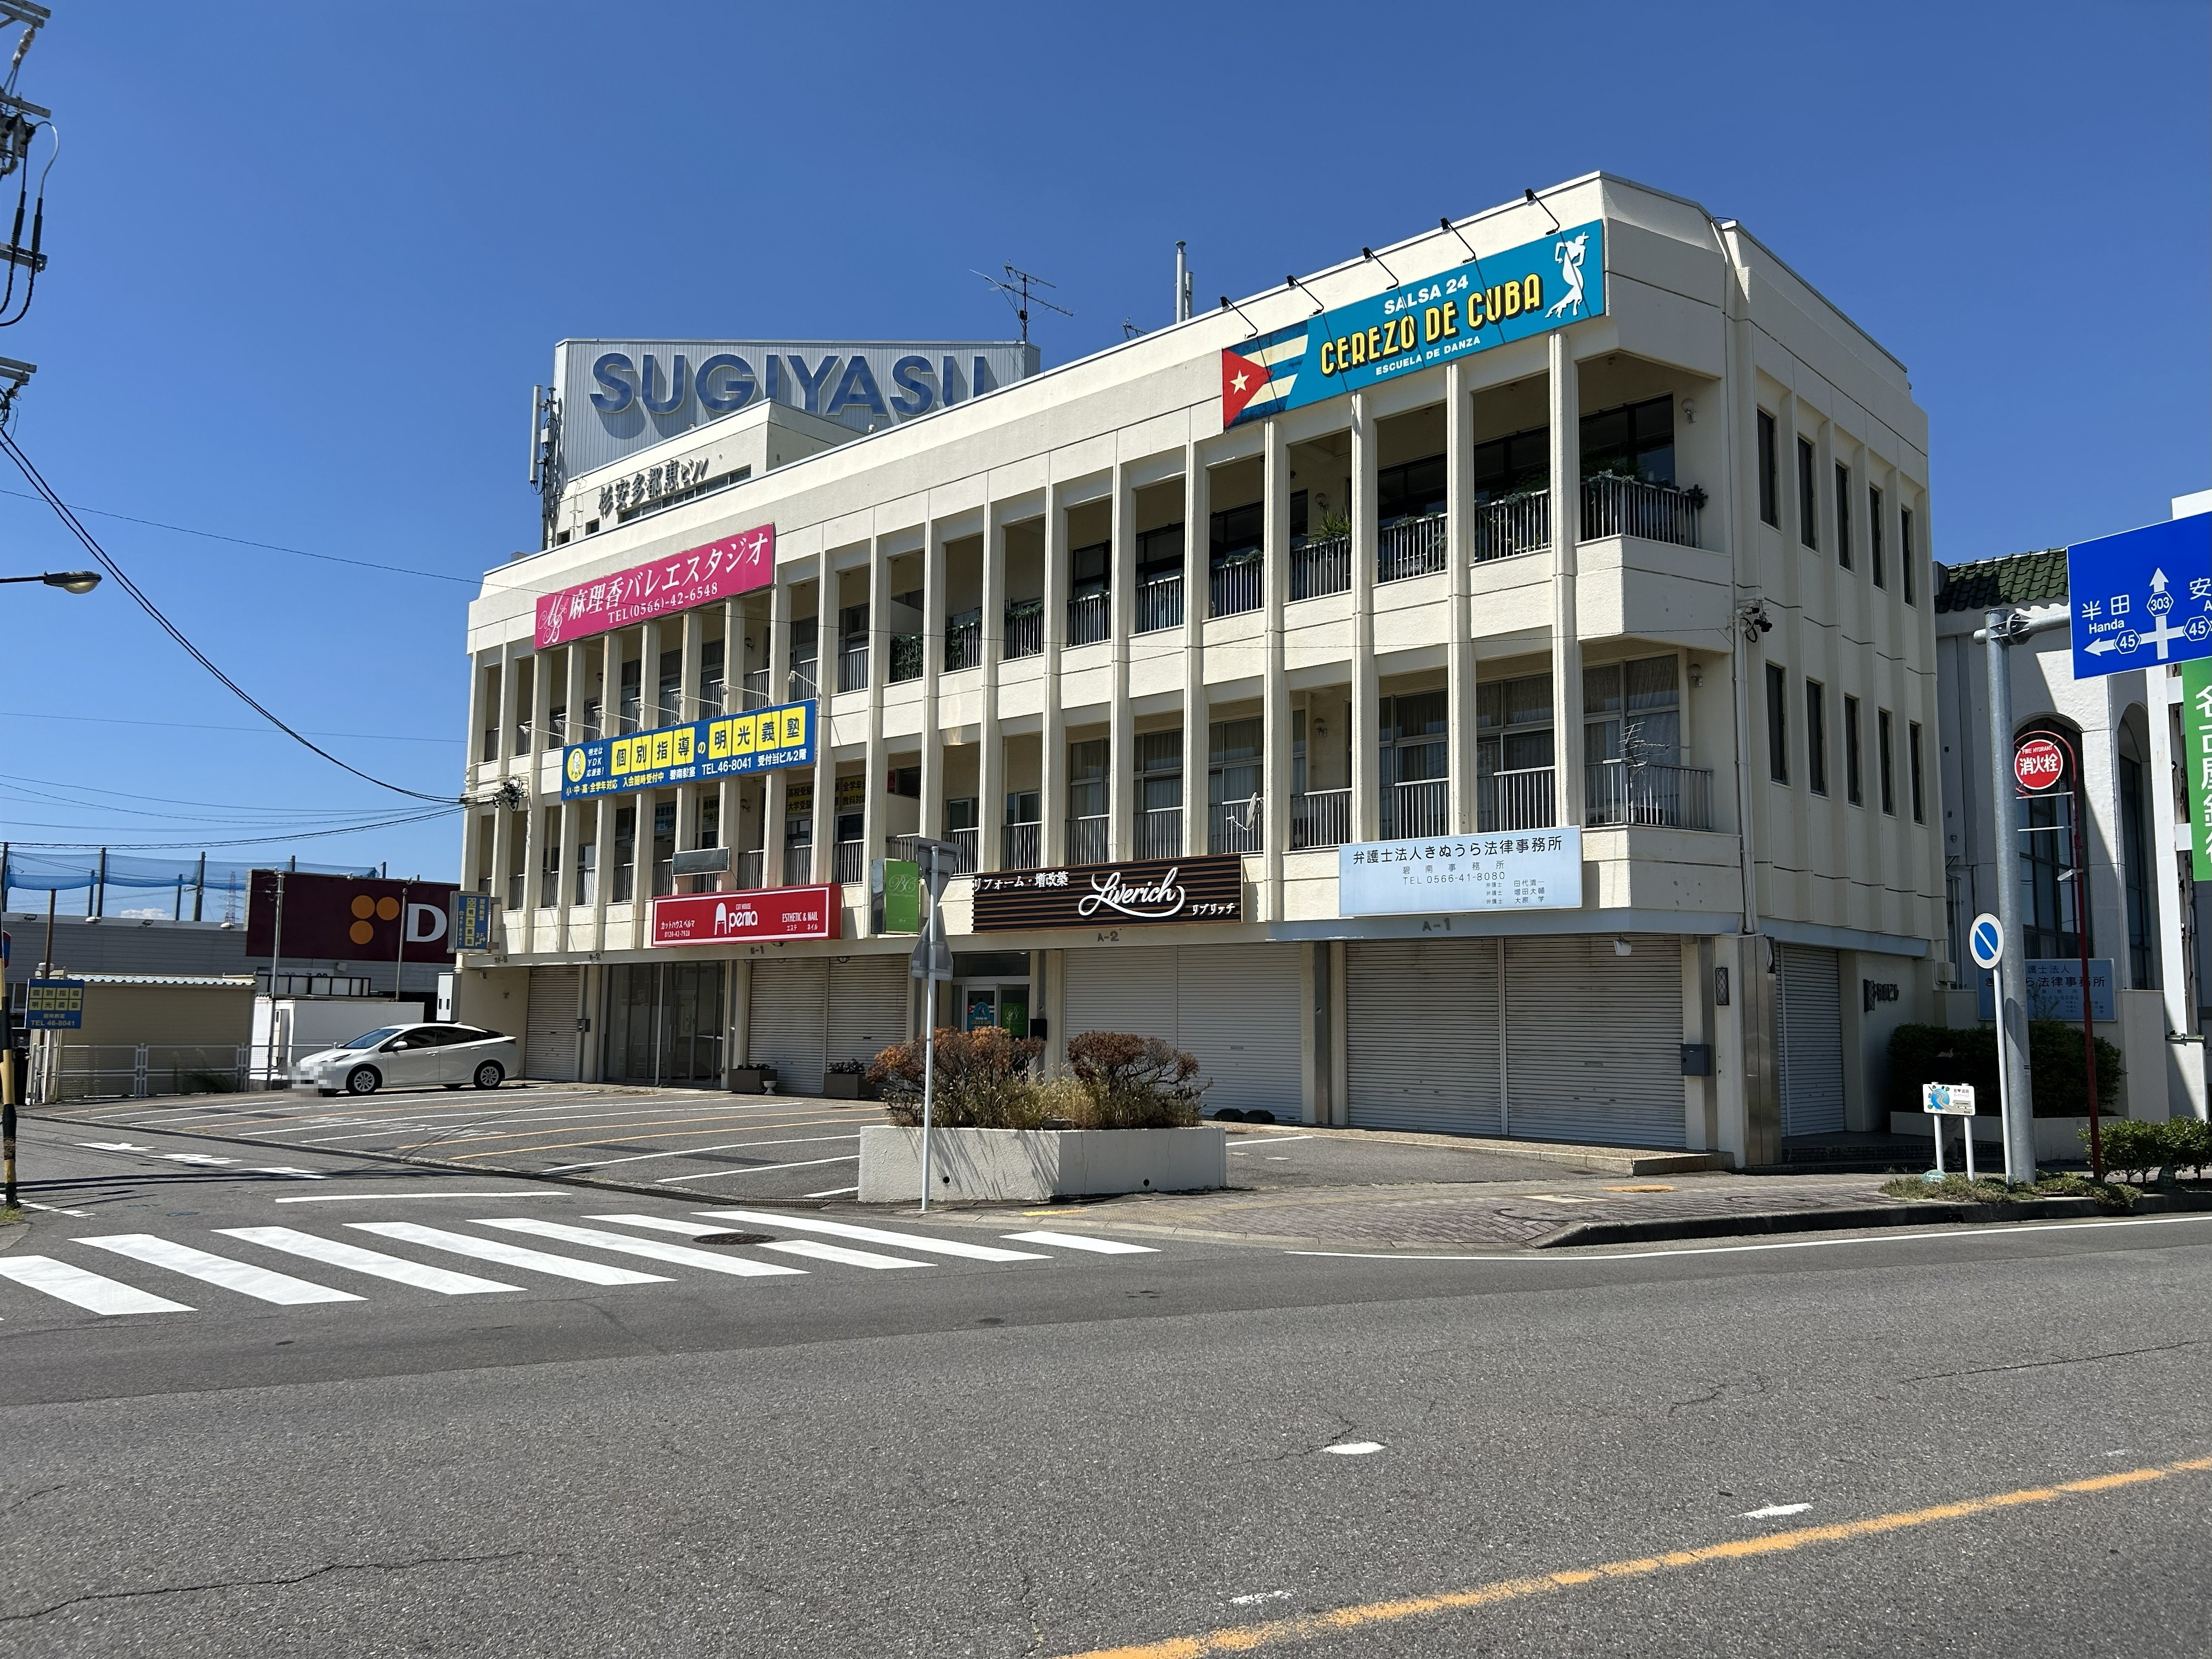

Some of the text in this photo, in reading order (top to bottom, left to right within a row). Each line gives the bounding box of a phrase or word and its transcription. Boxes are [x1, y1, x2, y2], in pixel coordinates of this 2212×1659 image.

[1384, 275, 1468, 315] SALSA 24
[1321, 273, 1541, 375] CEREZO DE CUBA
[1375, 336, 1481, 376] ESCUELA DE DANZA
[590, 353, 988, 417] SUGIYASU
[568, 533, 768, 621] 麻理香バレエスタジオ
[2081, 594, 2130, 620] 半田
[2151, 597, 2170, 611] 303
[2089, 619, 2125, 634] Handa
[2189, 621, 2205, 635] 45
[2120, 634, 2135, 648] 45
[588, 757, 602, 766] YDK
[2019, 753, 2058, 776] 消火栓
[670, 766, 696, 781] 碧南教室
[1353, 836, 1562, 865] 弁護士法人きぬうら法律事務所
[1403, 860, 1505, 874] 碧南事務所
[1403, 872, 1505, 885] TEL 0566-41-8080
[1078, 867, 1186, 917] Liverich
[782, 911, 818, 922] ESTHETIC & NAIL
[661, 920, 683, 929] カットハウス
[1423, 918, 1451, 931] A-1
[1097, 930, 1119, 942] A-2
